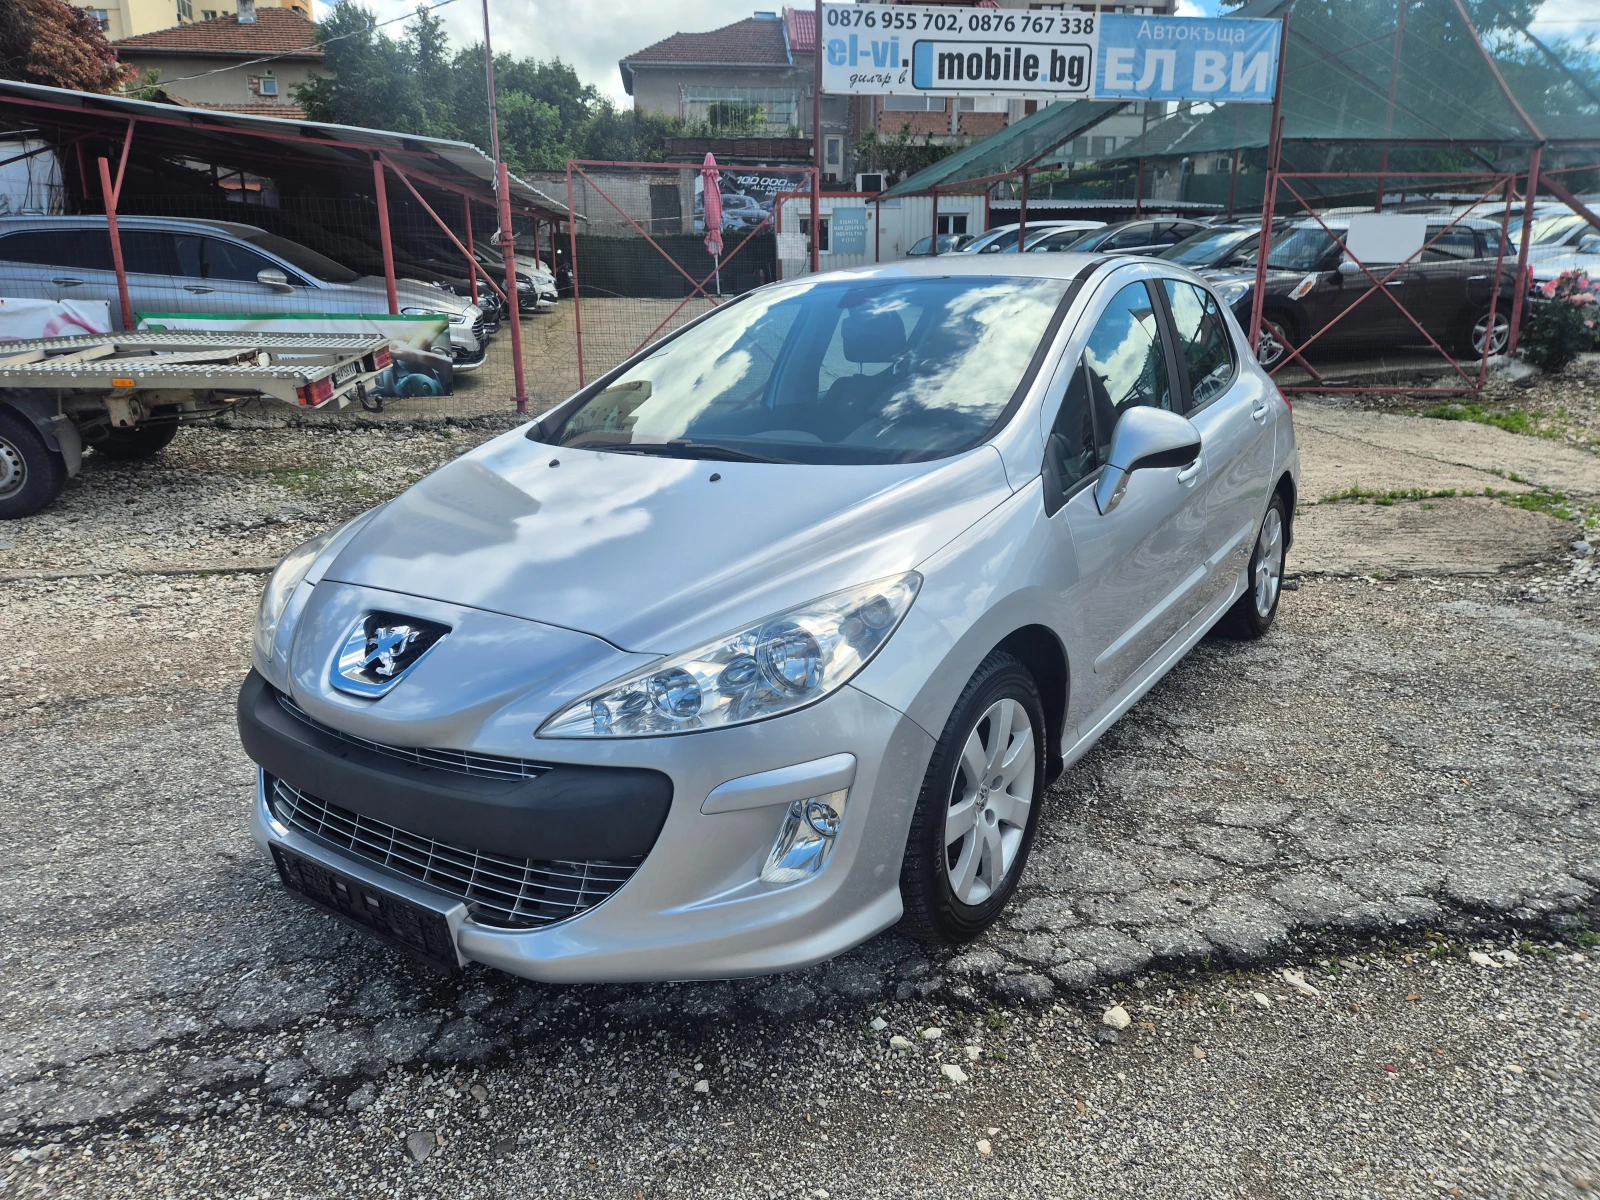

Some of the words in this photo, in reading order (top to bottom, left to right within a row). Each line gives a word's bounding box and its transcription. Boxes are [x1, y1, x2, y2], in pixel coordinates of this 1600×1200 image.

[827, 9, 876, 27] 0876
[881, 12, 917, 30] 955
[922, 14, 963, 33] 702,
[968, 14, 1016, 32] 0876
[1020, 17, 1055, 34] 767
[1059, 18, 1094, 35] 338
[1137, 20, 1246, 45] Автокъща
[849, 71, 892, 88] дилър
[938, 47, 1085, 87] mobile.bg
[1104, 47, 1177, 92] ЕЛ
[1191, 50, 1269, 93] ВИ
[736, 176, 760, 185] 100
[760, 177, 787, 186] 000
